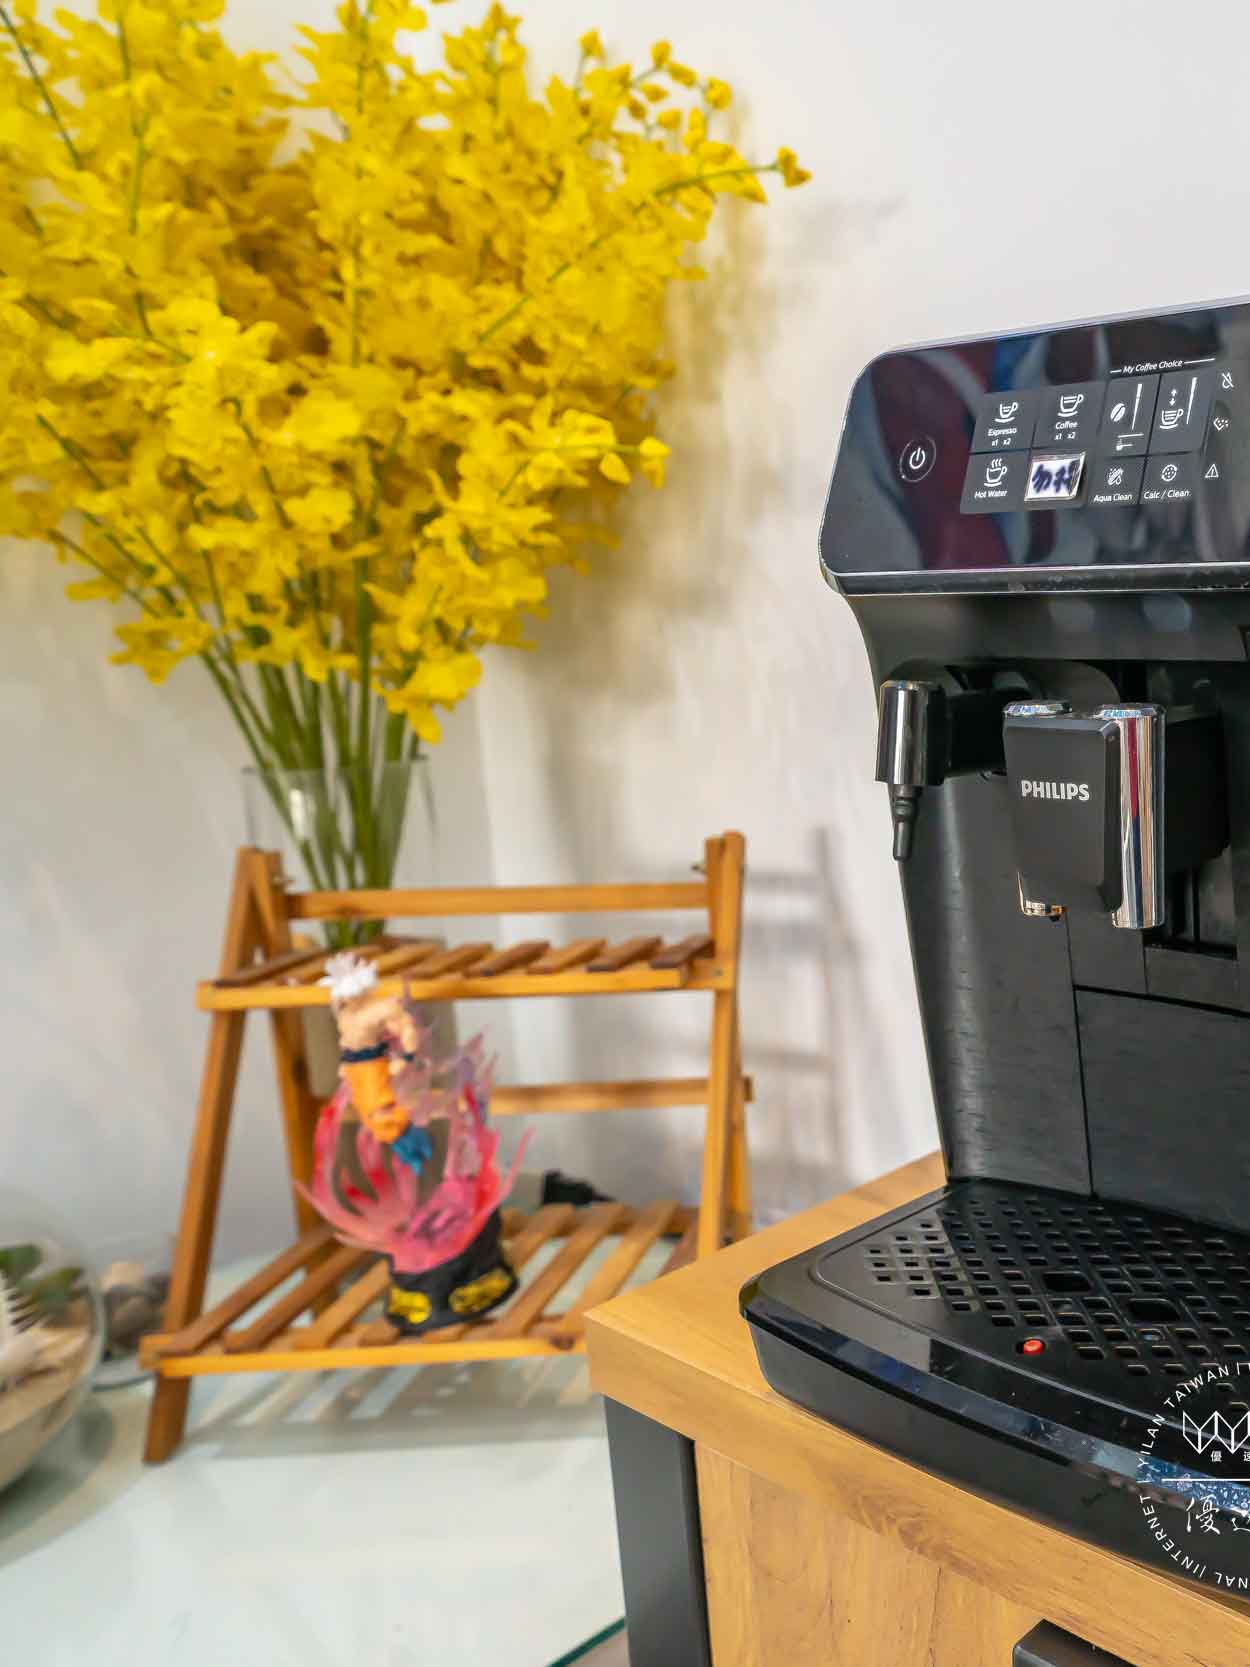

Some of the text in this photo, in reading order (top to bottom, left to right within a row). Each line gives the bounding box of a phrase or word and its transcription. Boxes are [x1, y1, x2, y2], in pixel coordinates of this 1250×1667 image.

[1122, 360, 1183, 374] My Coffee Choice
[1055, 421, 1078, 430] Coffee
[987, 427, 1017, 437] Espresso
[974, 489, 1008, 499] Hot Water
[1093, 492, 1133, 502] Aqua Clean
[1143, 491, 1160, 499] Calc
[1167, 489, 1190, 498] Clean
[1021, 779, 1090, 801] PHILIPS
